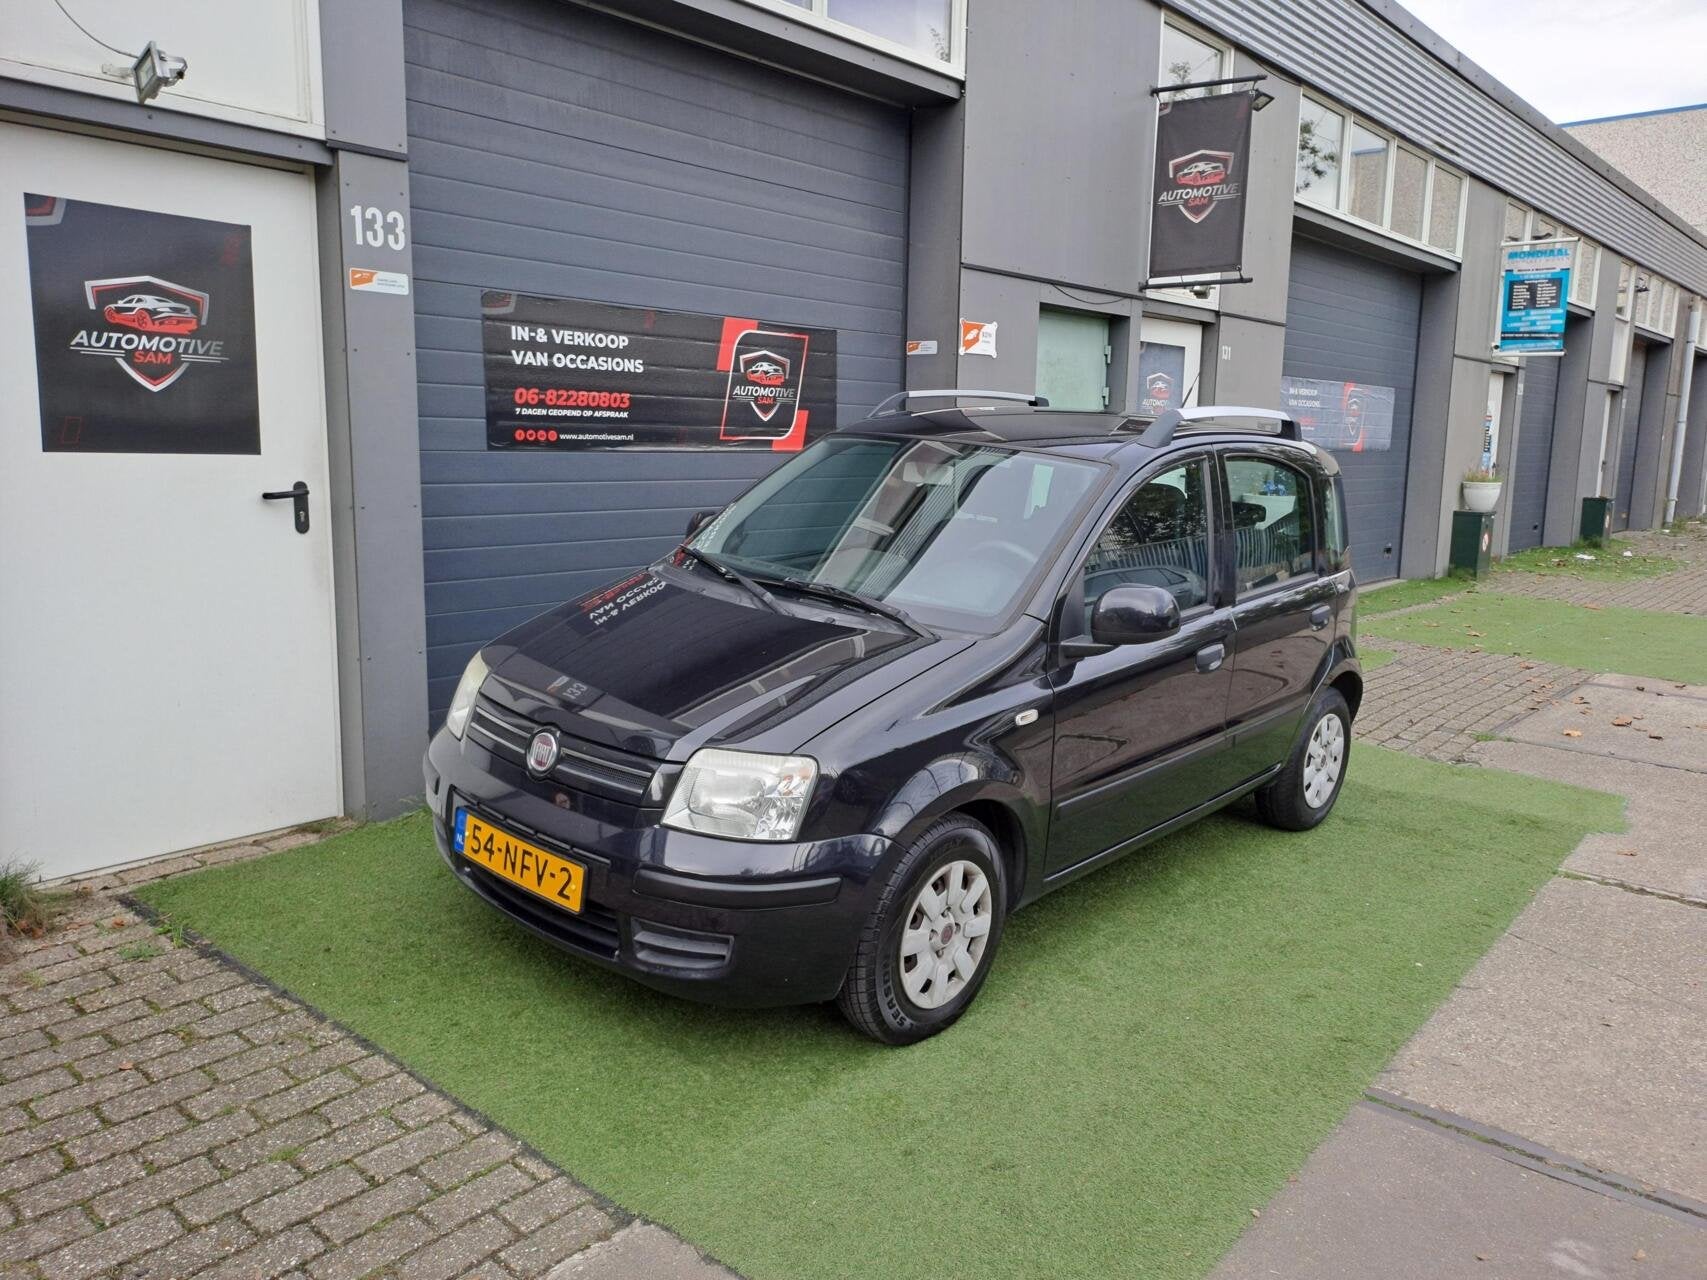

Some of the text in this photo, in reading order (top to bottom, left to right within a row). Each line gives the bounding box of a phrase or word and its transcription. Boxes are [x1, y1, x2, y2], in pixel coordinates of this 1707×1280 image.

[1159, 183, 1238, 201] AUTOMOTIVE
[350, 205, 406, 251] 133
[70, 330, 224, 357] AUTOMOTIVE
[511, 326, 629, 349] IN-& VERKOOP
[134, 350, 173, 365] SAM
[512, 350, 645, 373] VAN OCCASIONS
[514, 387, 631, 408] 06-82280803
[733, 386, 796, 398] AUTOMOTIVE
[522, 408, 548, 416] DAGEN
[548, 409, 581, 417] GEOPEND
[593, 410, 629, 418] AFSPRAAK
[559, 433, 634, 441] www.automotivesam.nl
[456, 833, 465, 845] NL
[470, 823, 573, 900] 54-NFV-2
